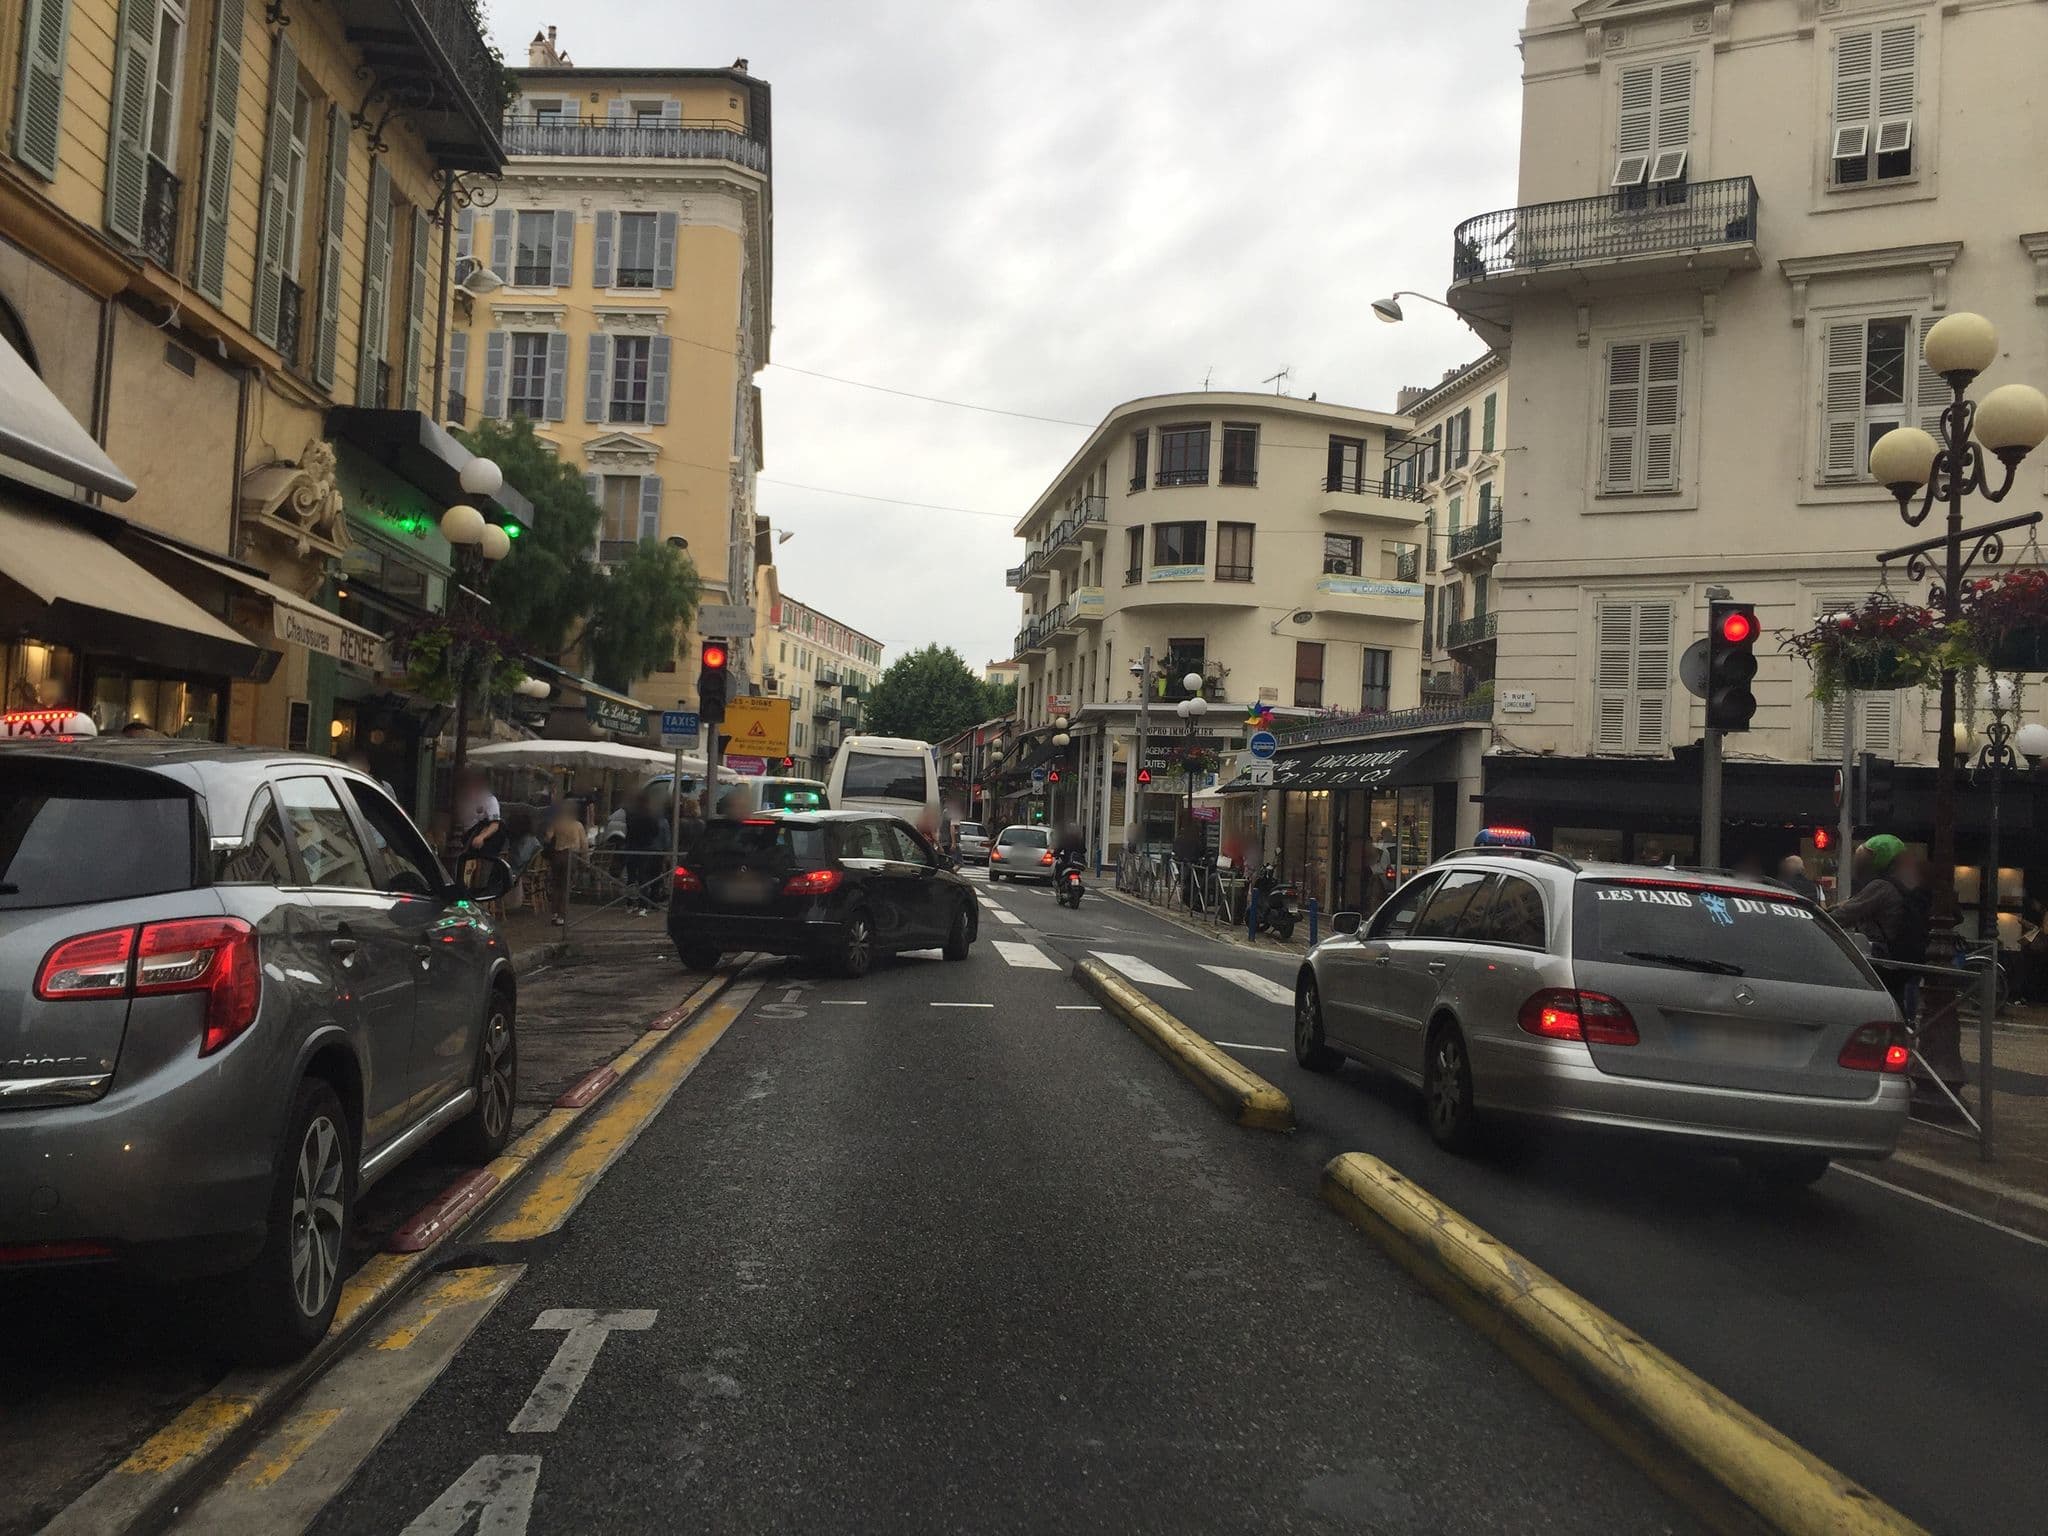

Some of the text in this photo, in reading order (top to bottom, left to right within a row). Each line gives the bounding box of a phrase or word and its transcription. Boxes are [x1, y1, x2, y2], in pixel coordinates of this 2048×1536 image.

[286, 615, 330, 652] Chaussures
[4, 719, 64, 737] TAXI
[664, 715, 696, 727] TAXIS
[1597, 889, 1693, 908] LES TAXIS
[1732, 898, 1814, 920] DU SUD
